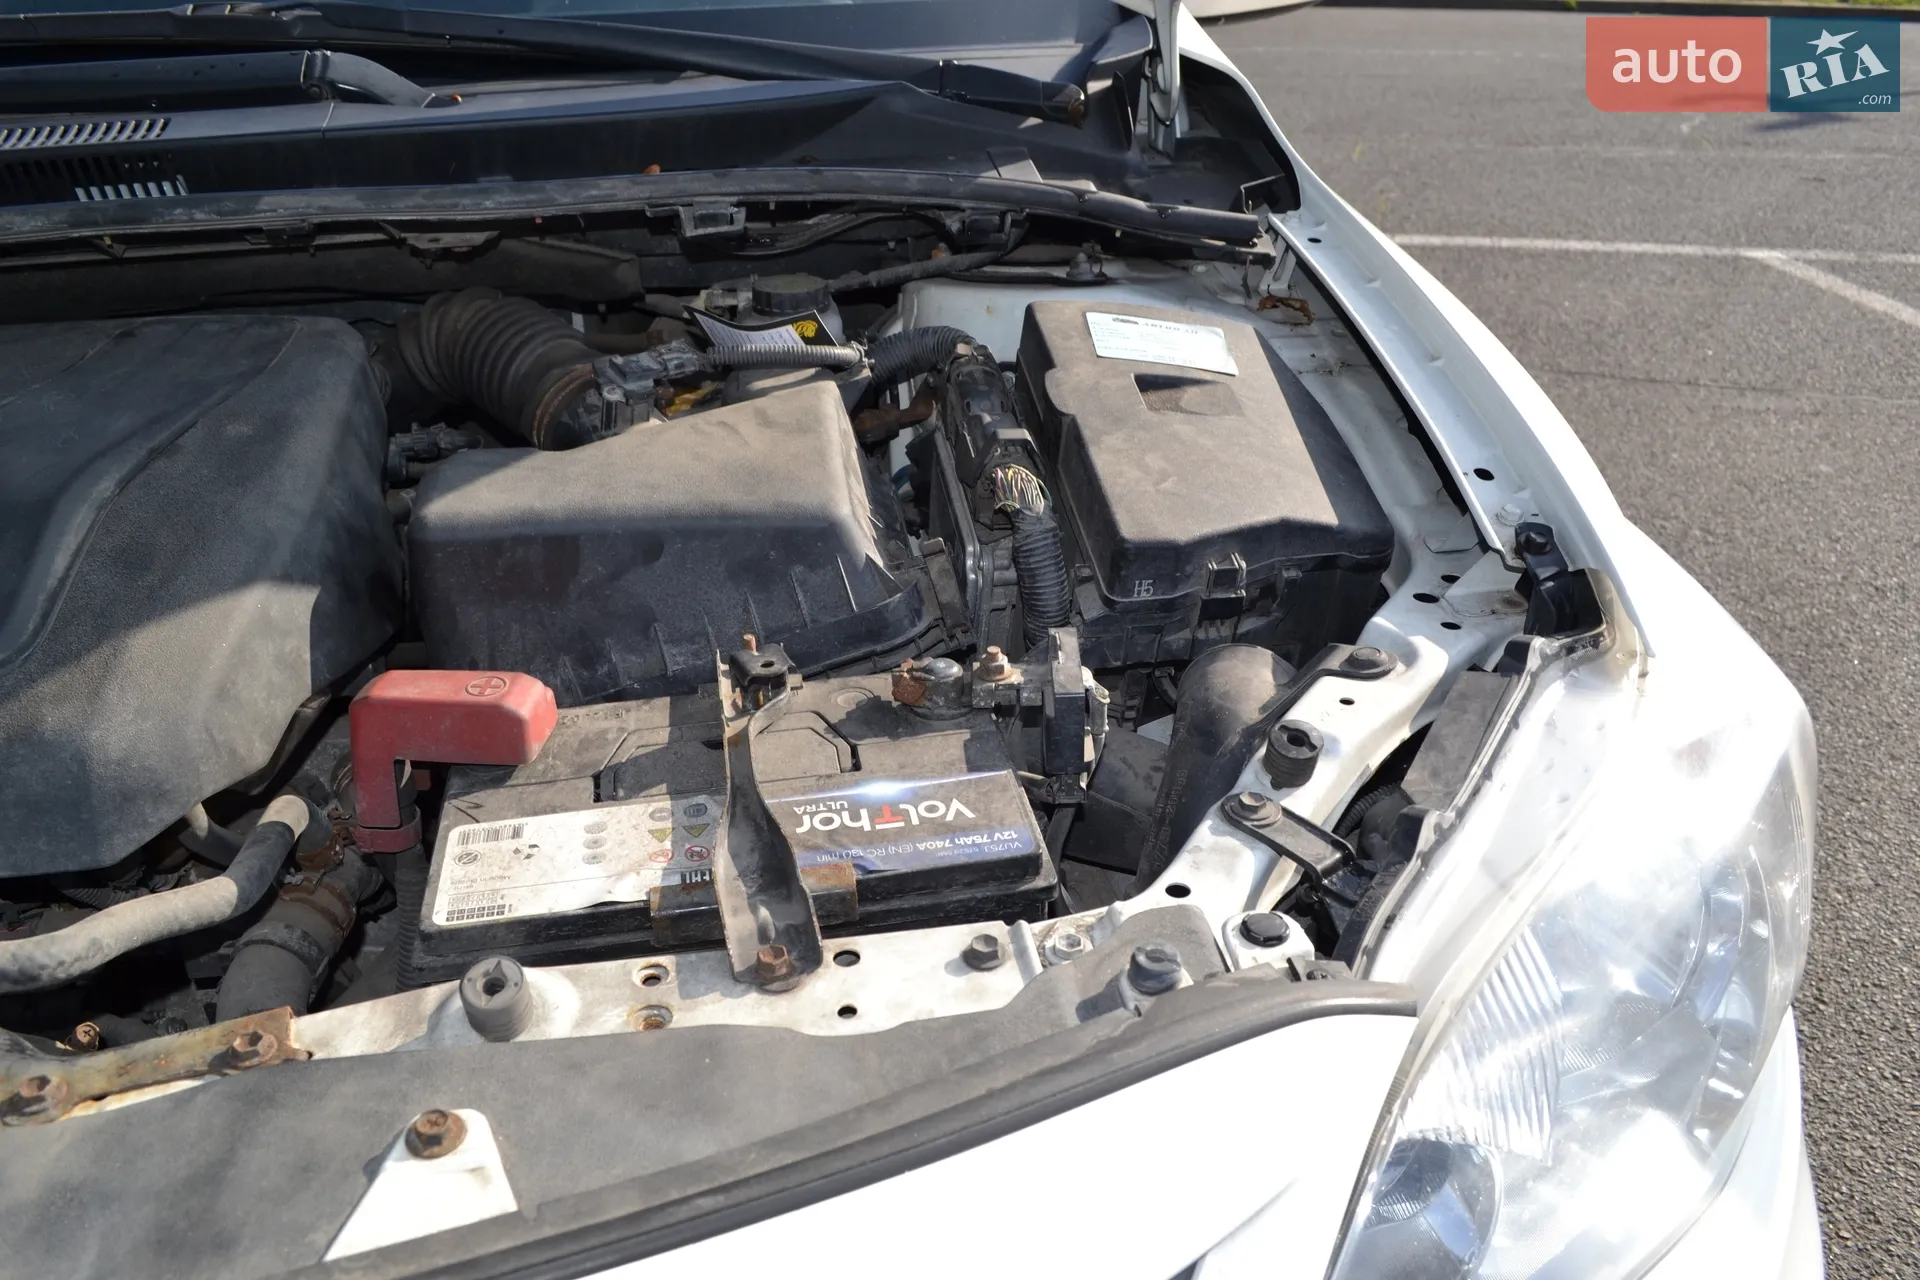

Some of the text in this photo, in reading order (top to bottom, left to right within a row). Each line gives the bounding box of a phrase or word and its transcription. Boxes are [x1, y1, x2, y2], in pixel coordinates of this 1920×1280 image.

[793, 800, 848, 815] ULTRA
[956, 832, 991, 845] 75Ah
[993, 830, 1018, 841] 12V
[888, 842, 914, 855] (EN)
[916, 838, 953, 850] 740A
[984, 841, 1022, 852] VU75J
[817, 852, 842, 863] min
[869, 846, 887, 858] RC
